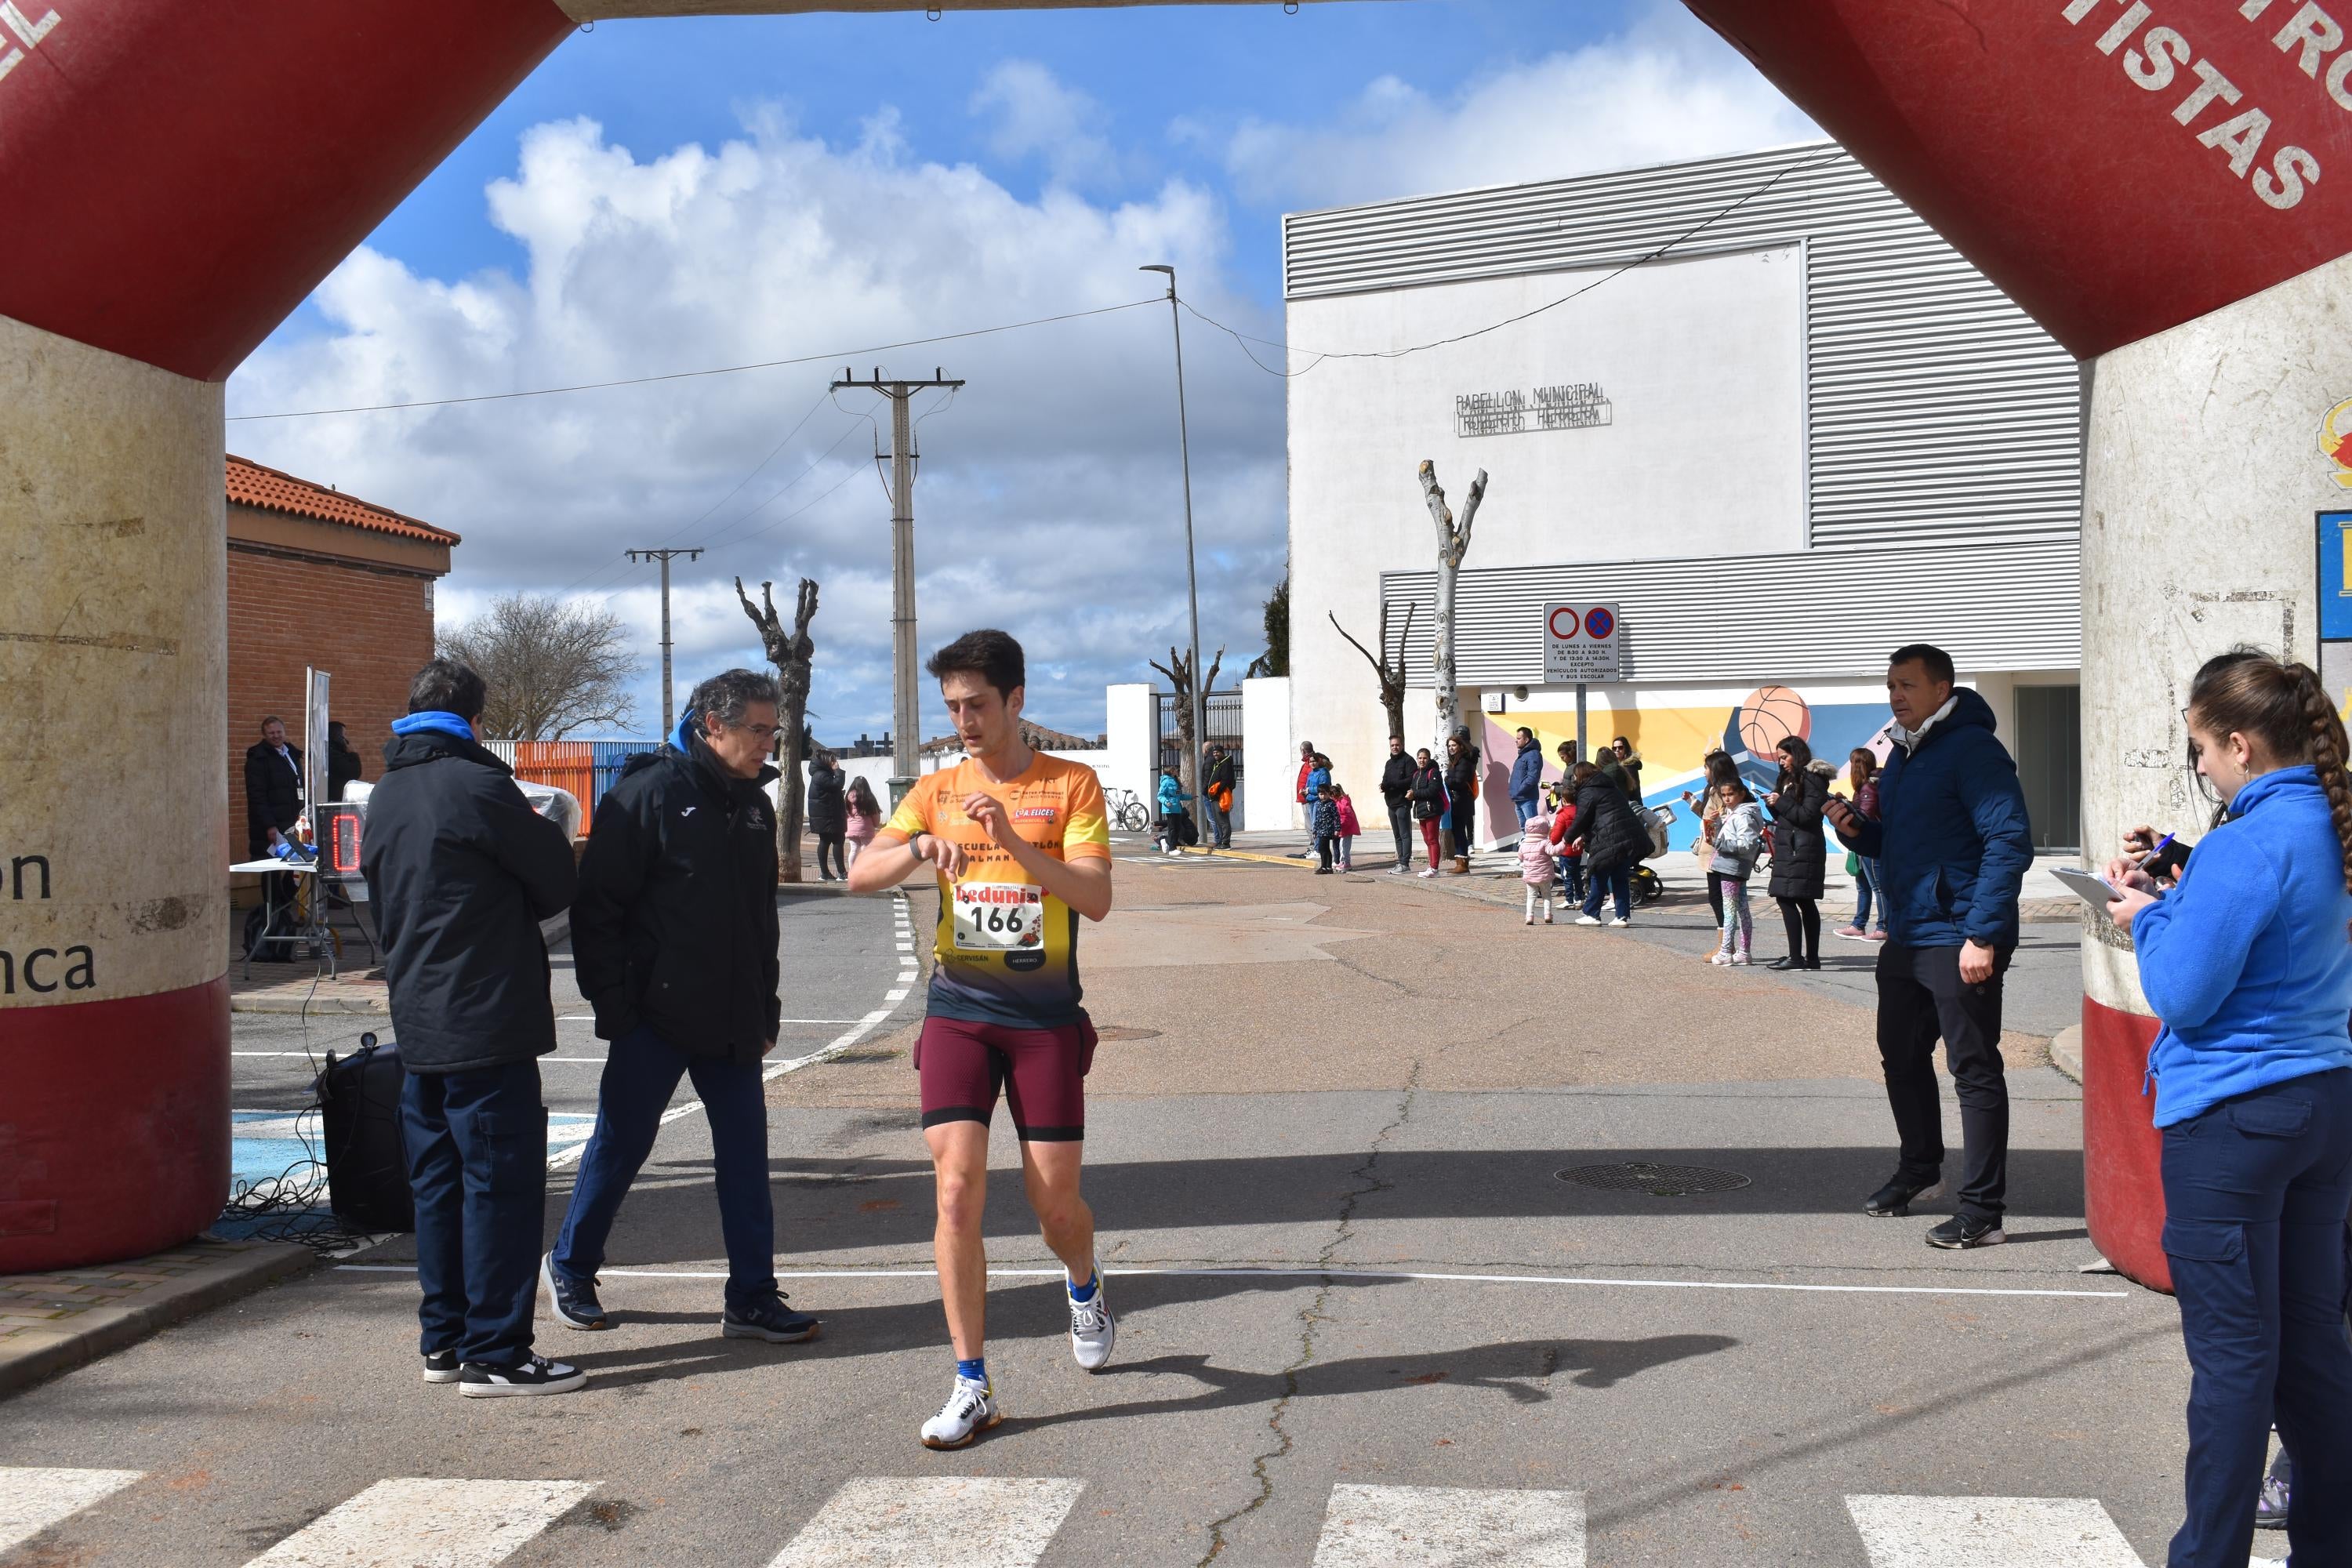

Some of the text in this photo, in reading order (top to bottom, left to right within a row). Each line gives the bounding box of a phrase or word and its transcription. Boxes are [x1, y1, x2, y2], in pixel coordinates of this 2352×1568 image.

[1533, 382, 1602, 405] MUNICIPAL
[1032, 840, 1060, 849] TLÓN
[971, 906, 1023, 933] 166
